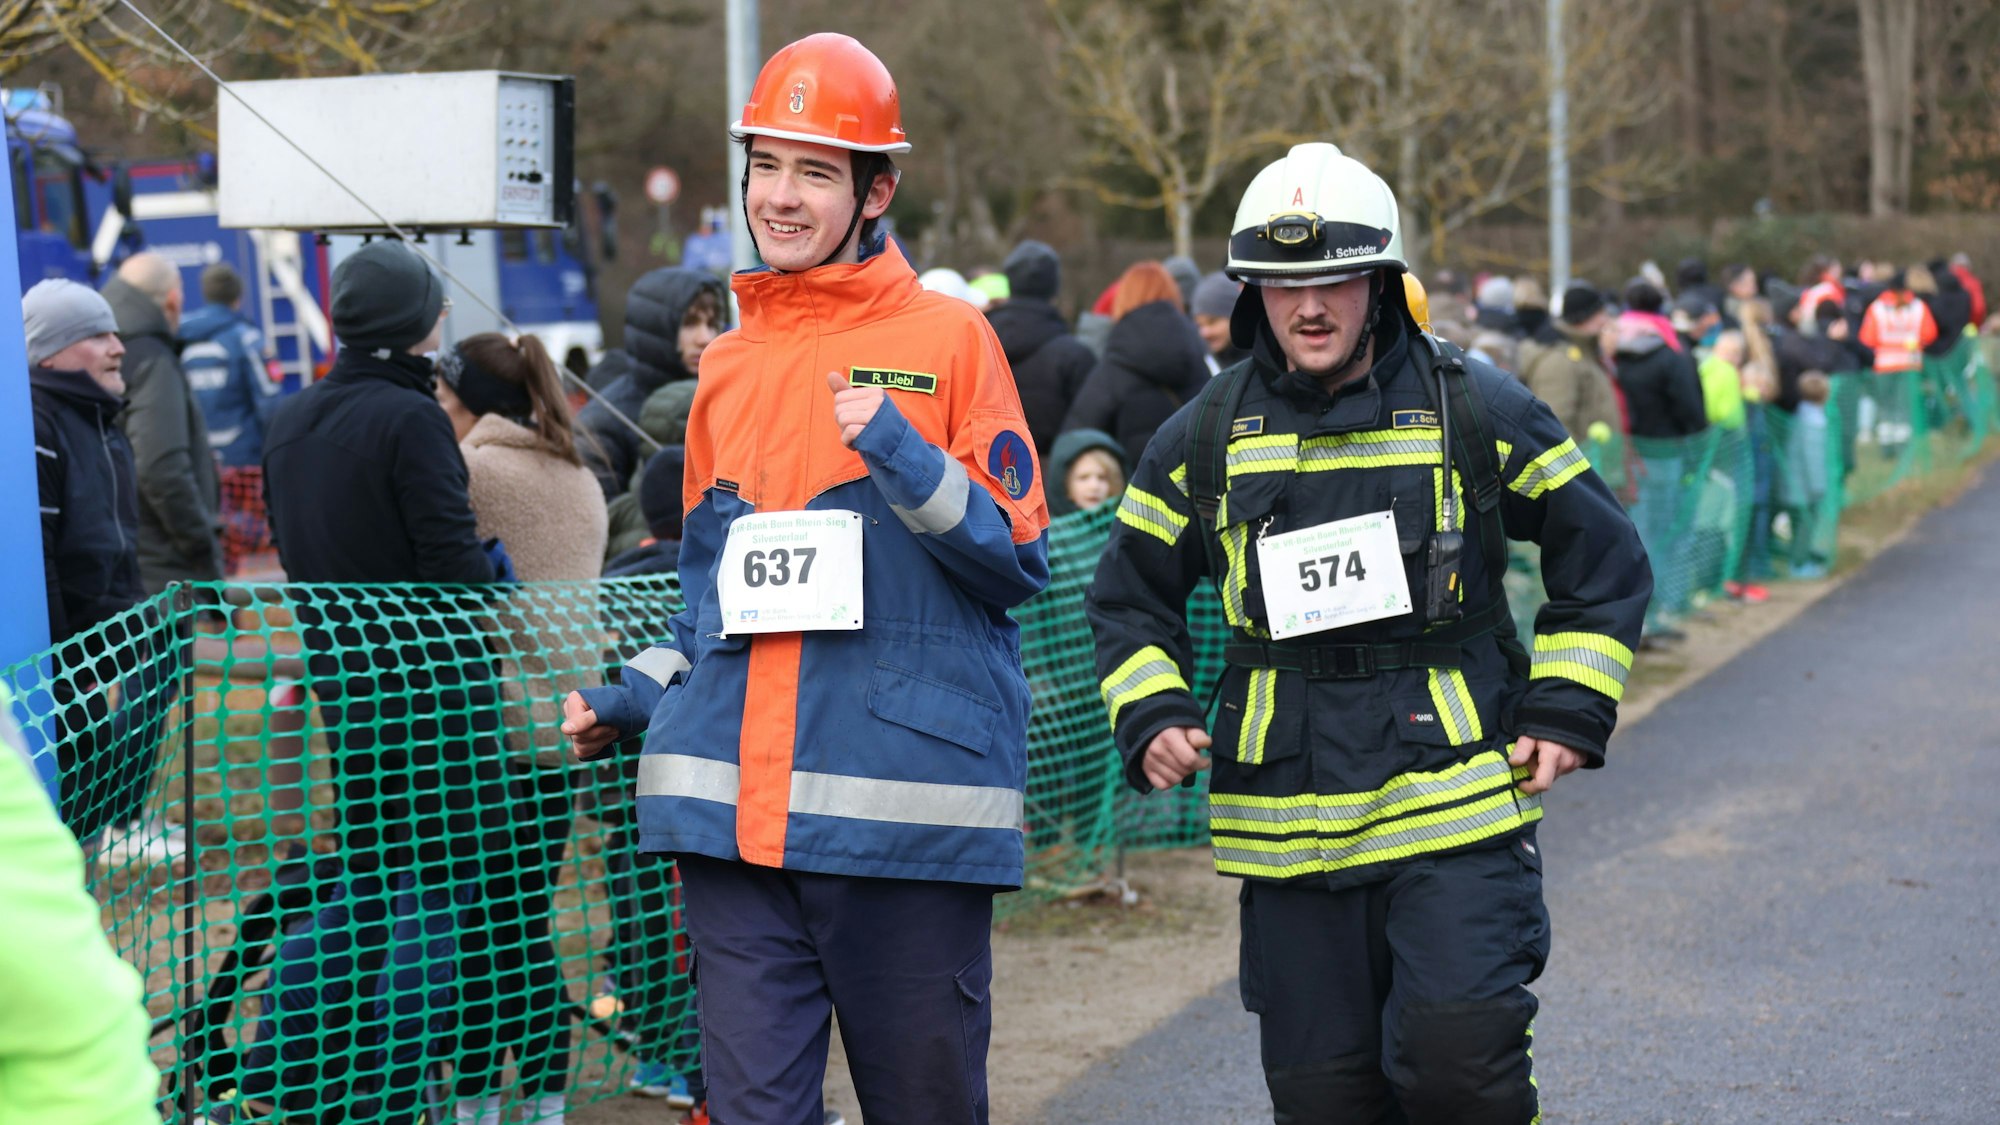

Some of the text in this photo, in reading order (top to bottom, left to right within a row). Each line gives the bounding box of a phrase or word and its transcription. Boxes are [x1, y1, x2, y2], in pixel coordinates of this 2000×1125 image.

[1292, 187, 1303, 206] A
[1324, 245, 1377, 259] J. Schröder
[872, 372, 914, 386] R. Liebl
[1409, 414, 1418, 423] J.
[770, 519, 793, 529] Bonn
[752, 532, 808, 545] Silvesterlauf
[1282, 534, 1315, 548] VR-Bank
[1317, 529, 1338, 539] Bonn
[1303, 538, 1353, 555] Silvesterlauf
[743, 547, 817, 588] 637
[1298, 550, 1366, 592] 574
